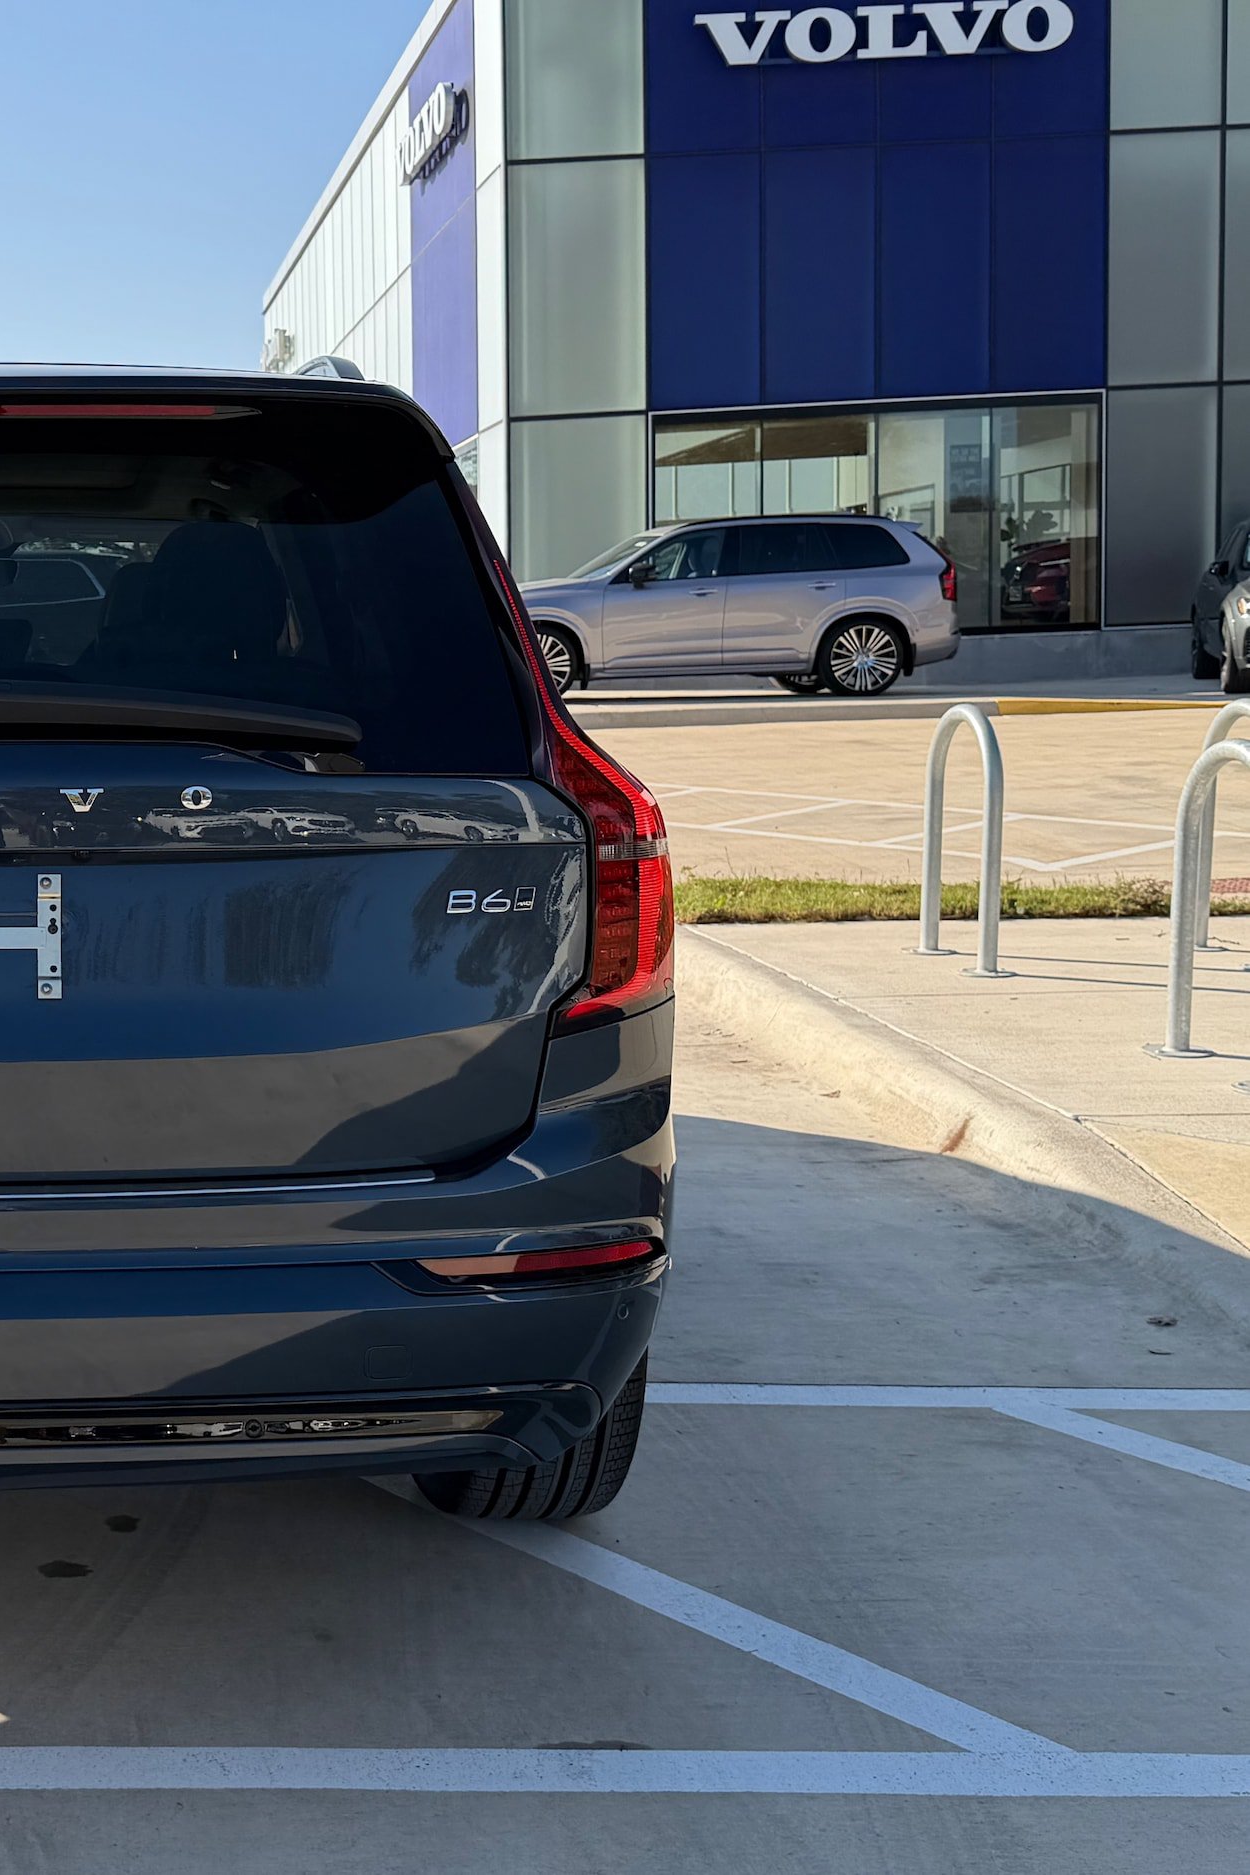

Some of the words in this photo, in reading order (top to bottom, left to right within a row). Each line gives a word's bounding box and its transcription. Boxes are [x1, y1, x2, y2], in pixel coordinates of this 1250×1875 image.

[694, 0, 1074, 66] VOLVO
[396, 82, 447, 186] VOLVO
[446, 888, 511, 914] B6
